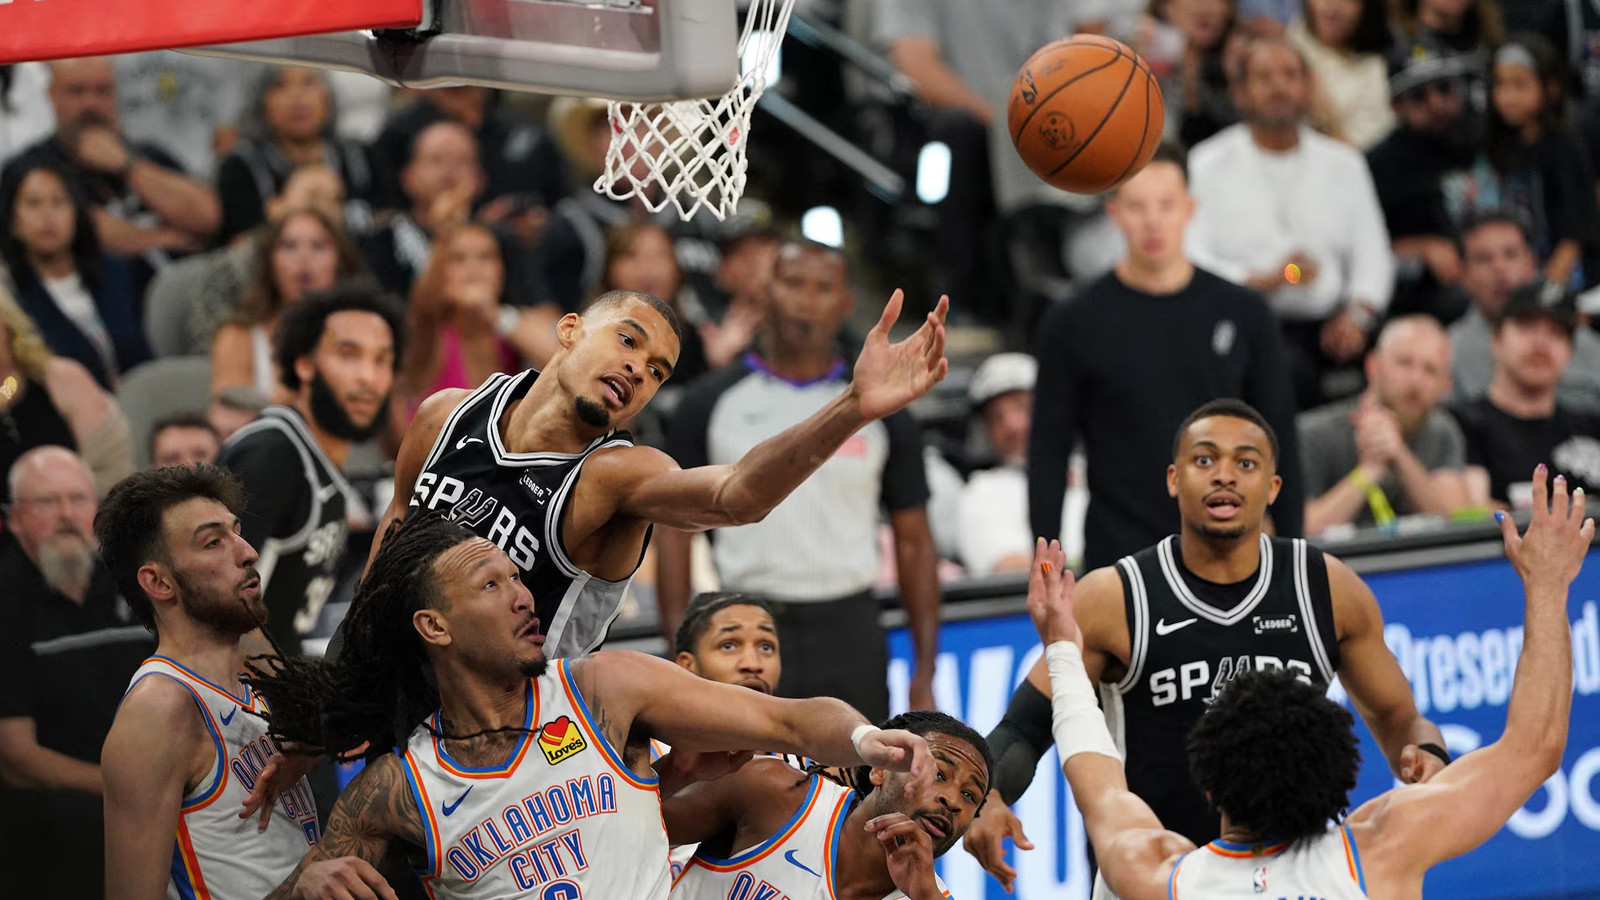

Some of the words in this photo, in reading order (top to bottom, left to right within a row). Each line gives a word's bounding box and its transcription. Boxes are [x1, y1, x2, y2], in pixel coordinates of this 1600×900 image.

[522, 474, 544, 498] LEDGER
[1259, 617, 1292, 630] LEDGER
[1384, 601, 1599, 715] Presed
[231, 734, 278, 794] OKLA
[446, 772, 617, 882] OKLAHOMA
[508, 828, 589, 891] CITY
